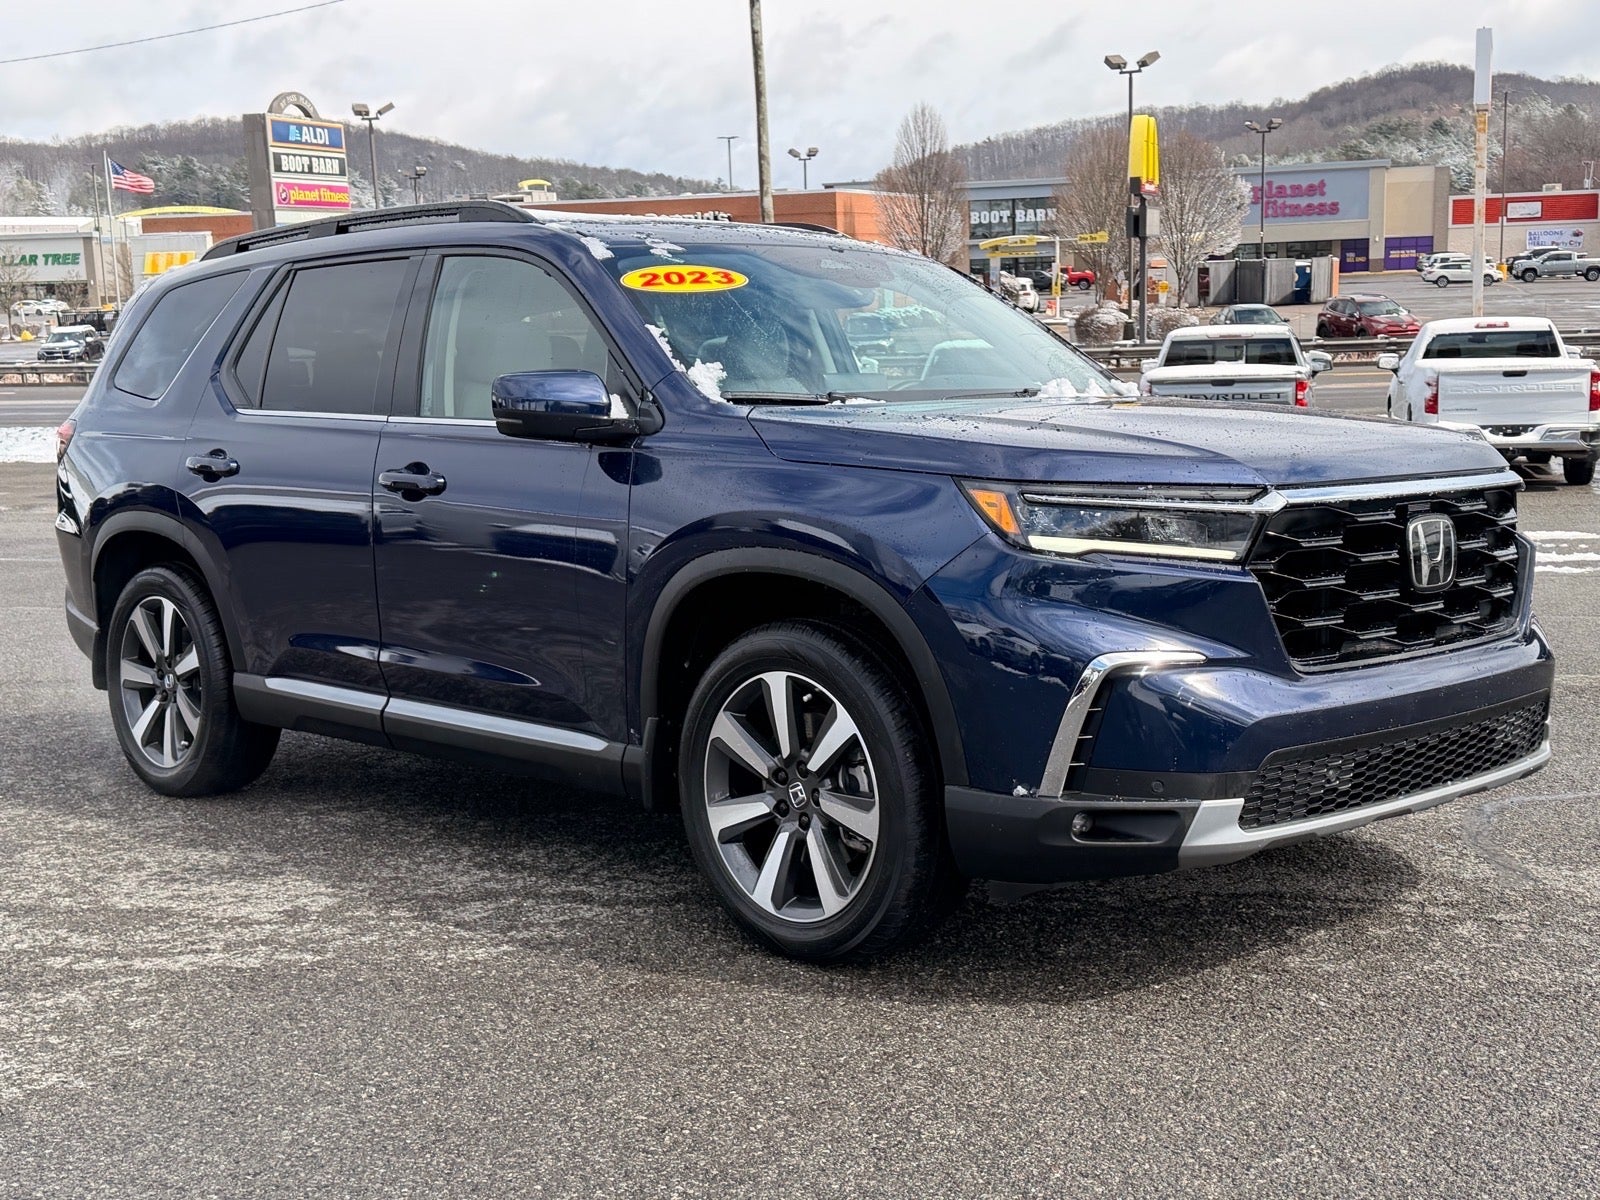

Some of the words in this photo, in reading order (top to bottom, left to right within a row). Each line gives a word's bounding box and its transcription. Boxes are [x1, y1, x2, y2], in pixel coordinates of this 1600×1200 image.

[301, 125, 330, 145] ALDI
[280, 154, 310, 172] BOOT
[311, 158, 341, 174] BARN
[289, 187, 319, 204] planet
[319, 188, 350, 203] fitness
[1251, 179, 1327, 205] planet
[970, 210, 1010, 224] BOOT
[1015, 207, 1058, 223] BARN
[1263, 199, 1340, 218] fitness
[0, 254, 38, 267] LLAR
[42, 253, 81, 266] TREE
[639, 271, 736, 287] 2023
